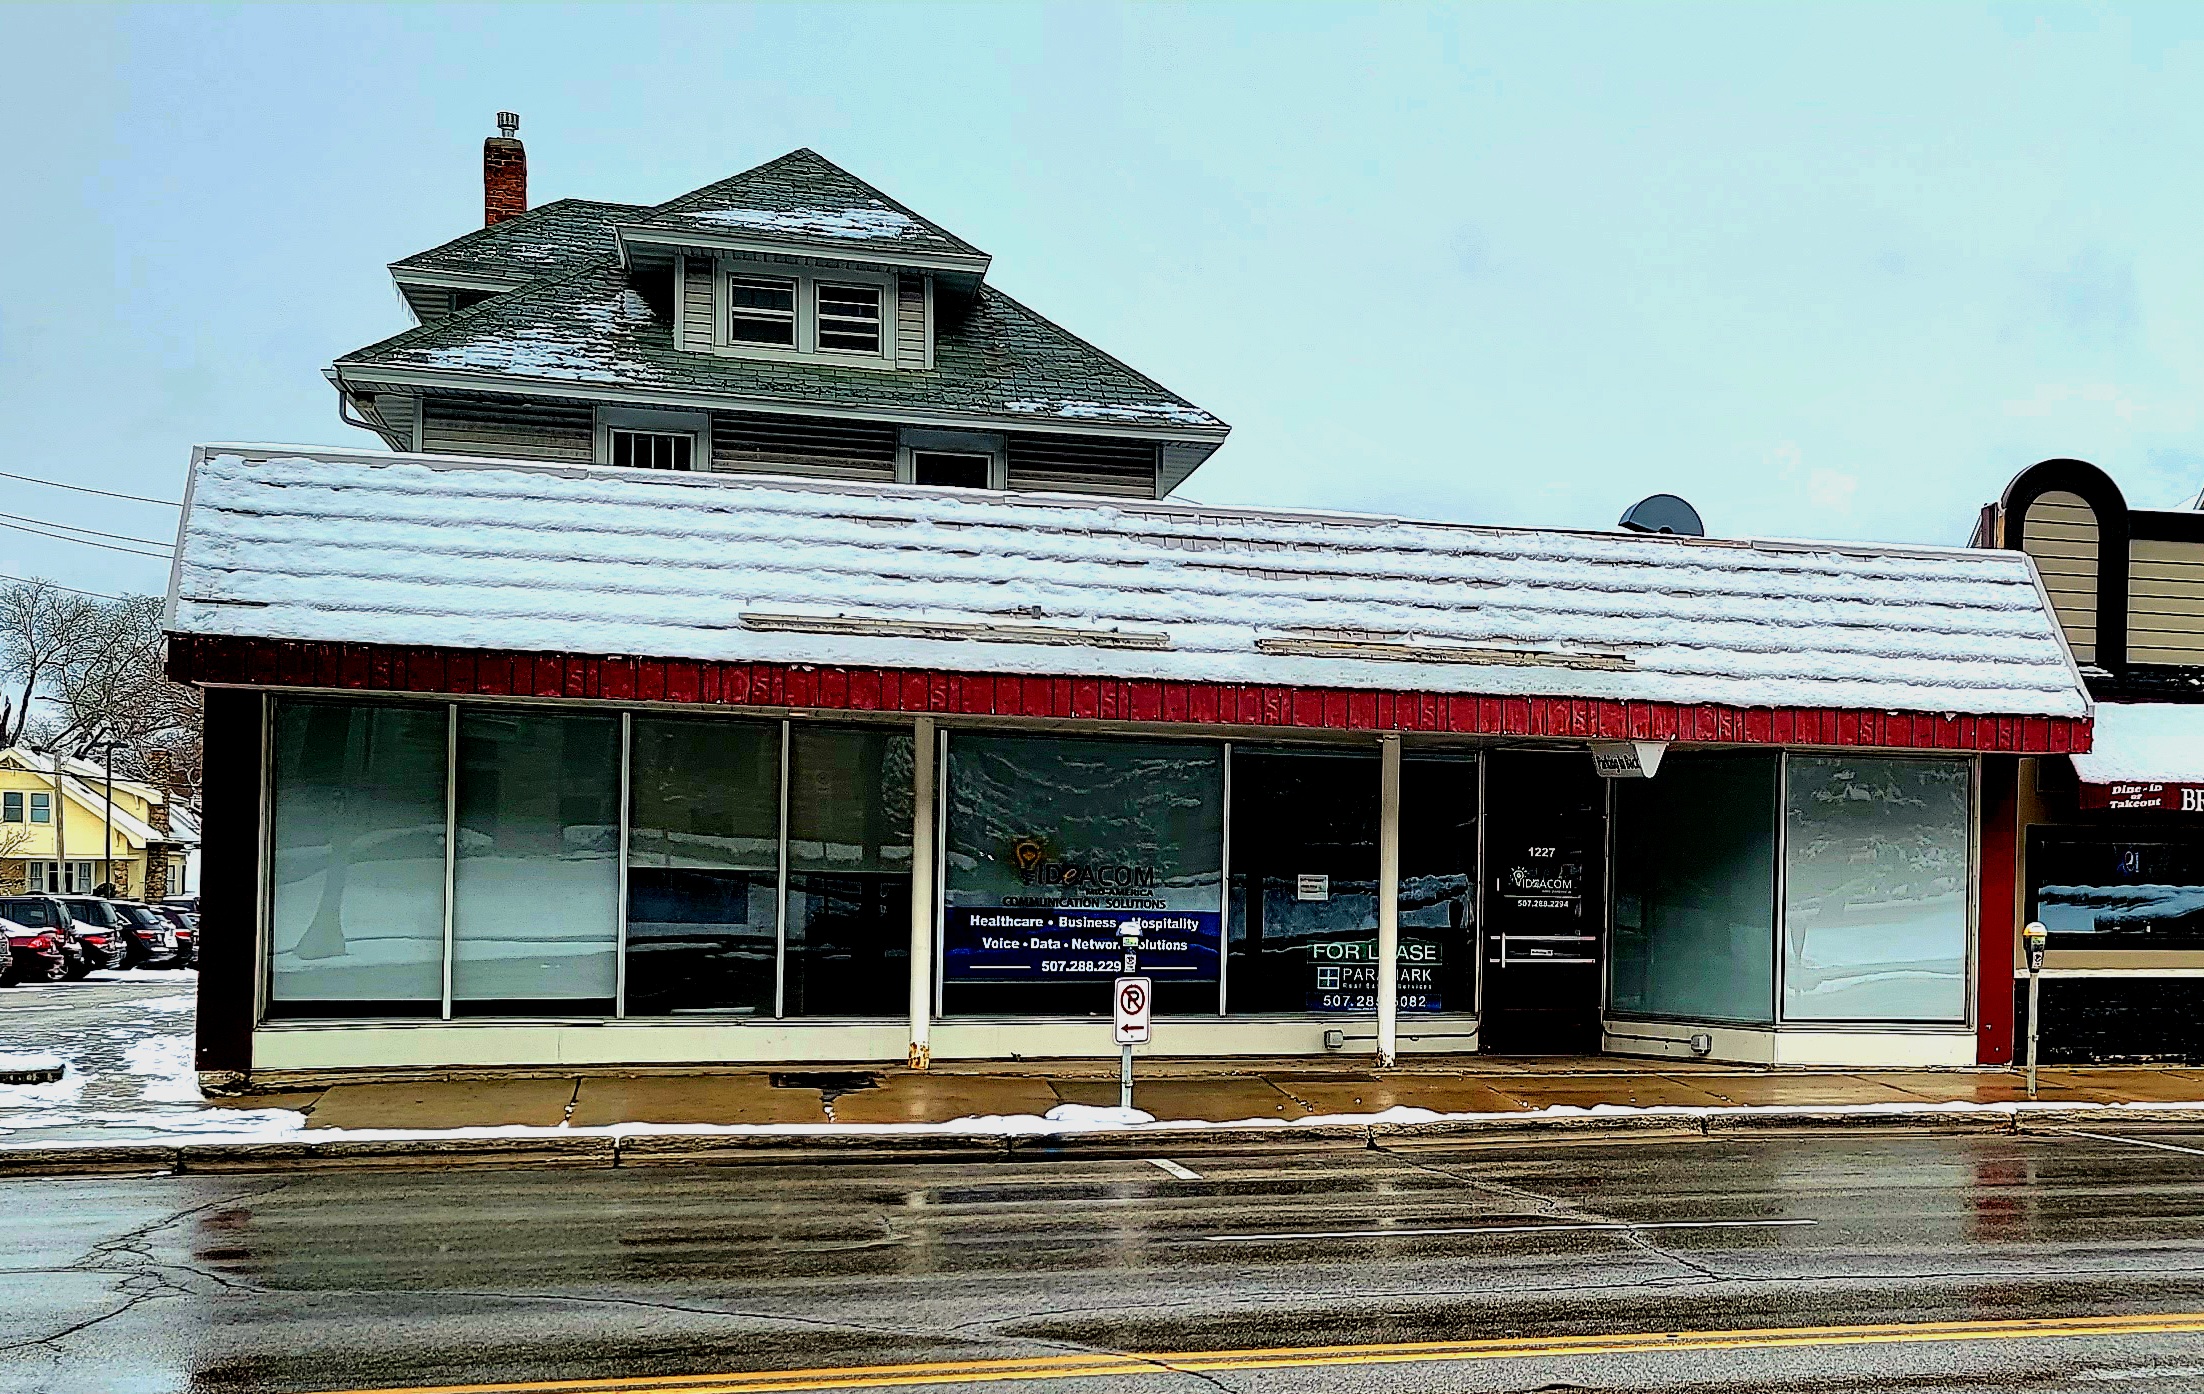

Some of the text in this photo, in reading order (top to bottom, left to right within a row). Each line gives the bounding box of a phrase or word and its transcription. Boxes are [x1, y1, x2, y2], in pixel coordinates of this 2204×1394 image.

[2109, 798, 2161, 809] Takeout
[1528, 847, 1556, 858] 1227
[1086, 888, 1154, 897] MID-AMERICA
[1002, 896, 1167, 909] COMMUNICATION SOLUTIONS
[970, 914, 1044, 927] Healthcare
[1058, 916, 1117, 929] Business
[982, 937, 1020, 949] Voice
[1030, 938, 1061, 950] Data
[1071, 938, 1121, 950] Networ
[1138, 939, 1188, 951] olutions
[1313, 943, 1437, 961] FOR LASE
[1041, 960, 1122, 972] 507.288.229
[1342, 967, 1432, 982] PARARK
[1323, 994, 1427, 1008] 507.28082
